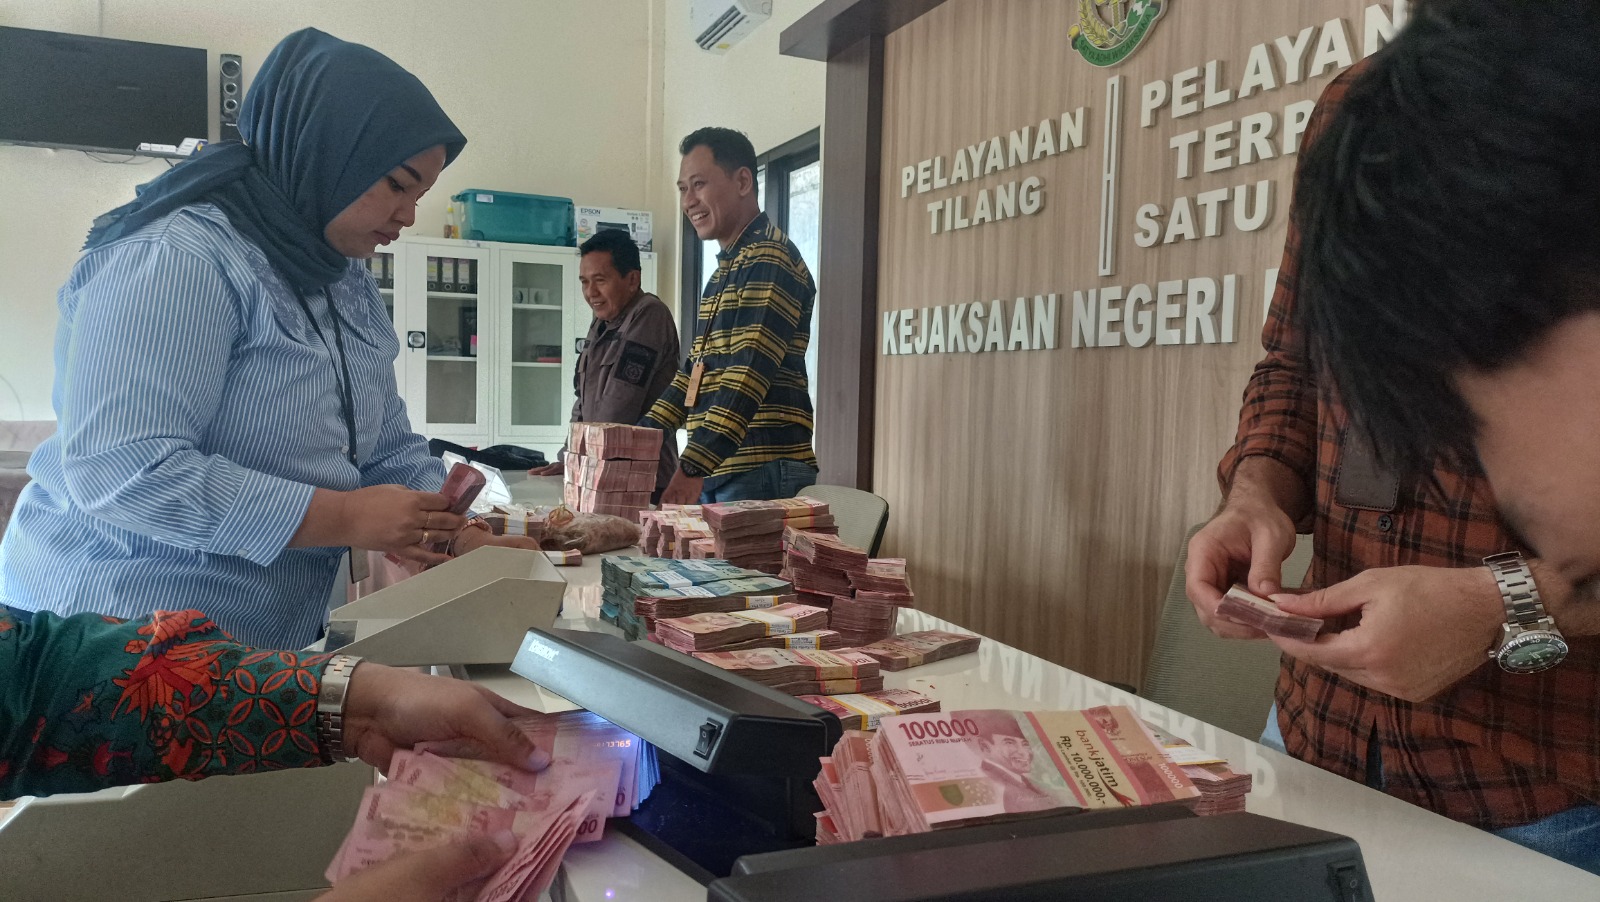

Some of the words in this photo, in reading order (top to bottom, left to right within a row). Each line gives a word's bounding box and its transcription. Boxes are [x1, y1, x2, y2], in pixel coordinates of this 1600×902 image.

[901, 107, 1088, 198] PELAYANAN
[927, 177, 1044, 234] TILANG
[1133, 179, 1274, 248] SATU
[882, 293, 1058, 356] KEJAKSAAN
[1071, 273, 1240, 349] NEGERI
[898, 718, 979, 740] 100000
[908, 739, 935, 747] SERATUS
[1059, 735, 1072, 750] Rp.
[1158, 762, 1184, 789] 100000
